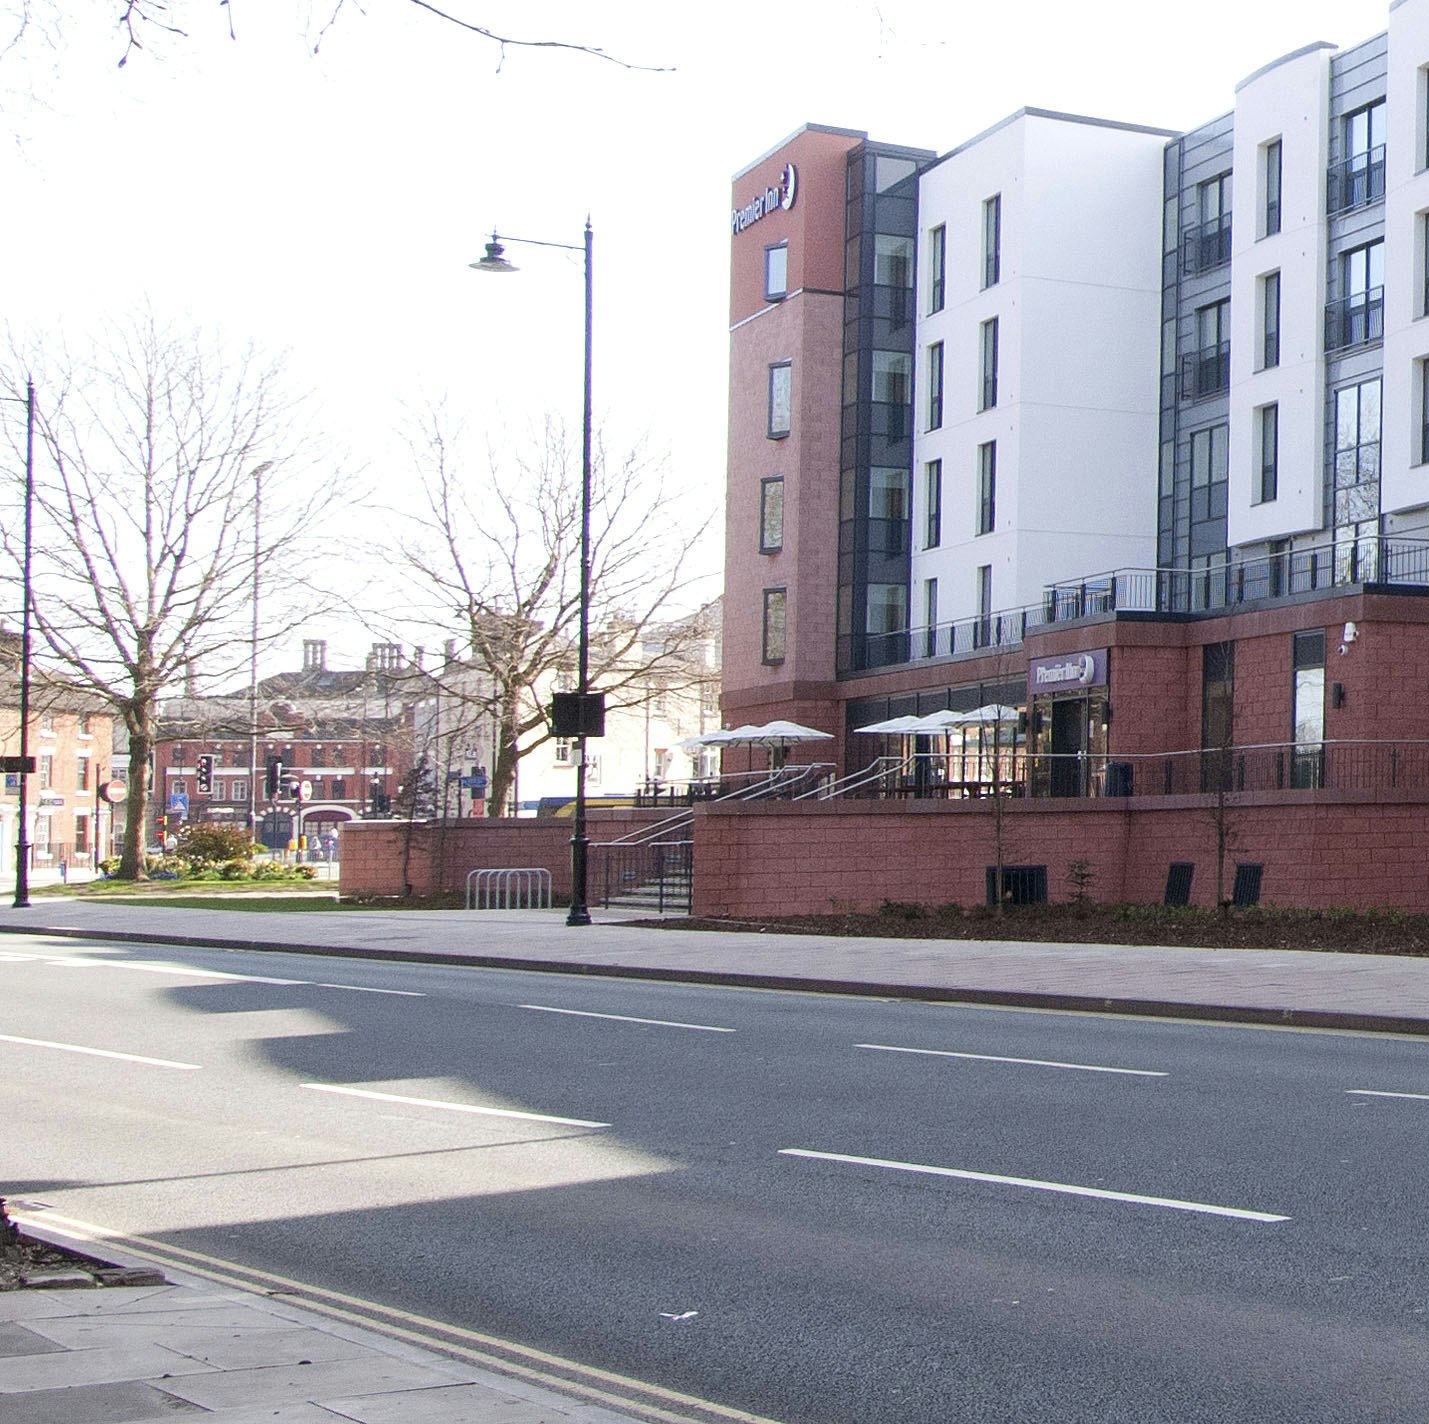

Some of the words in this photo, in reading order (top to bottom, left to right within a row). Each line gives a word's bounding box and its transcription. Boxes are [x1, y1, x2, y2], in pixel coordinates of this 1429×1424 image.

[731, 196, 764, 235] Premier
[765, 187, 780, 214] Inn
[1036, 664, 1065, 684] Premier
